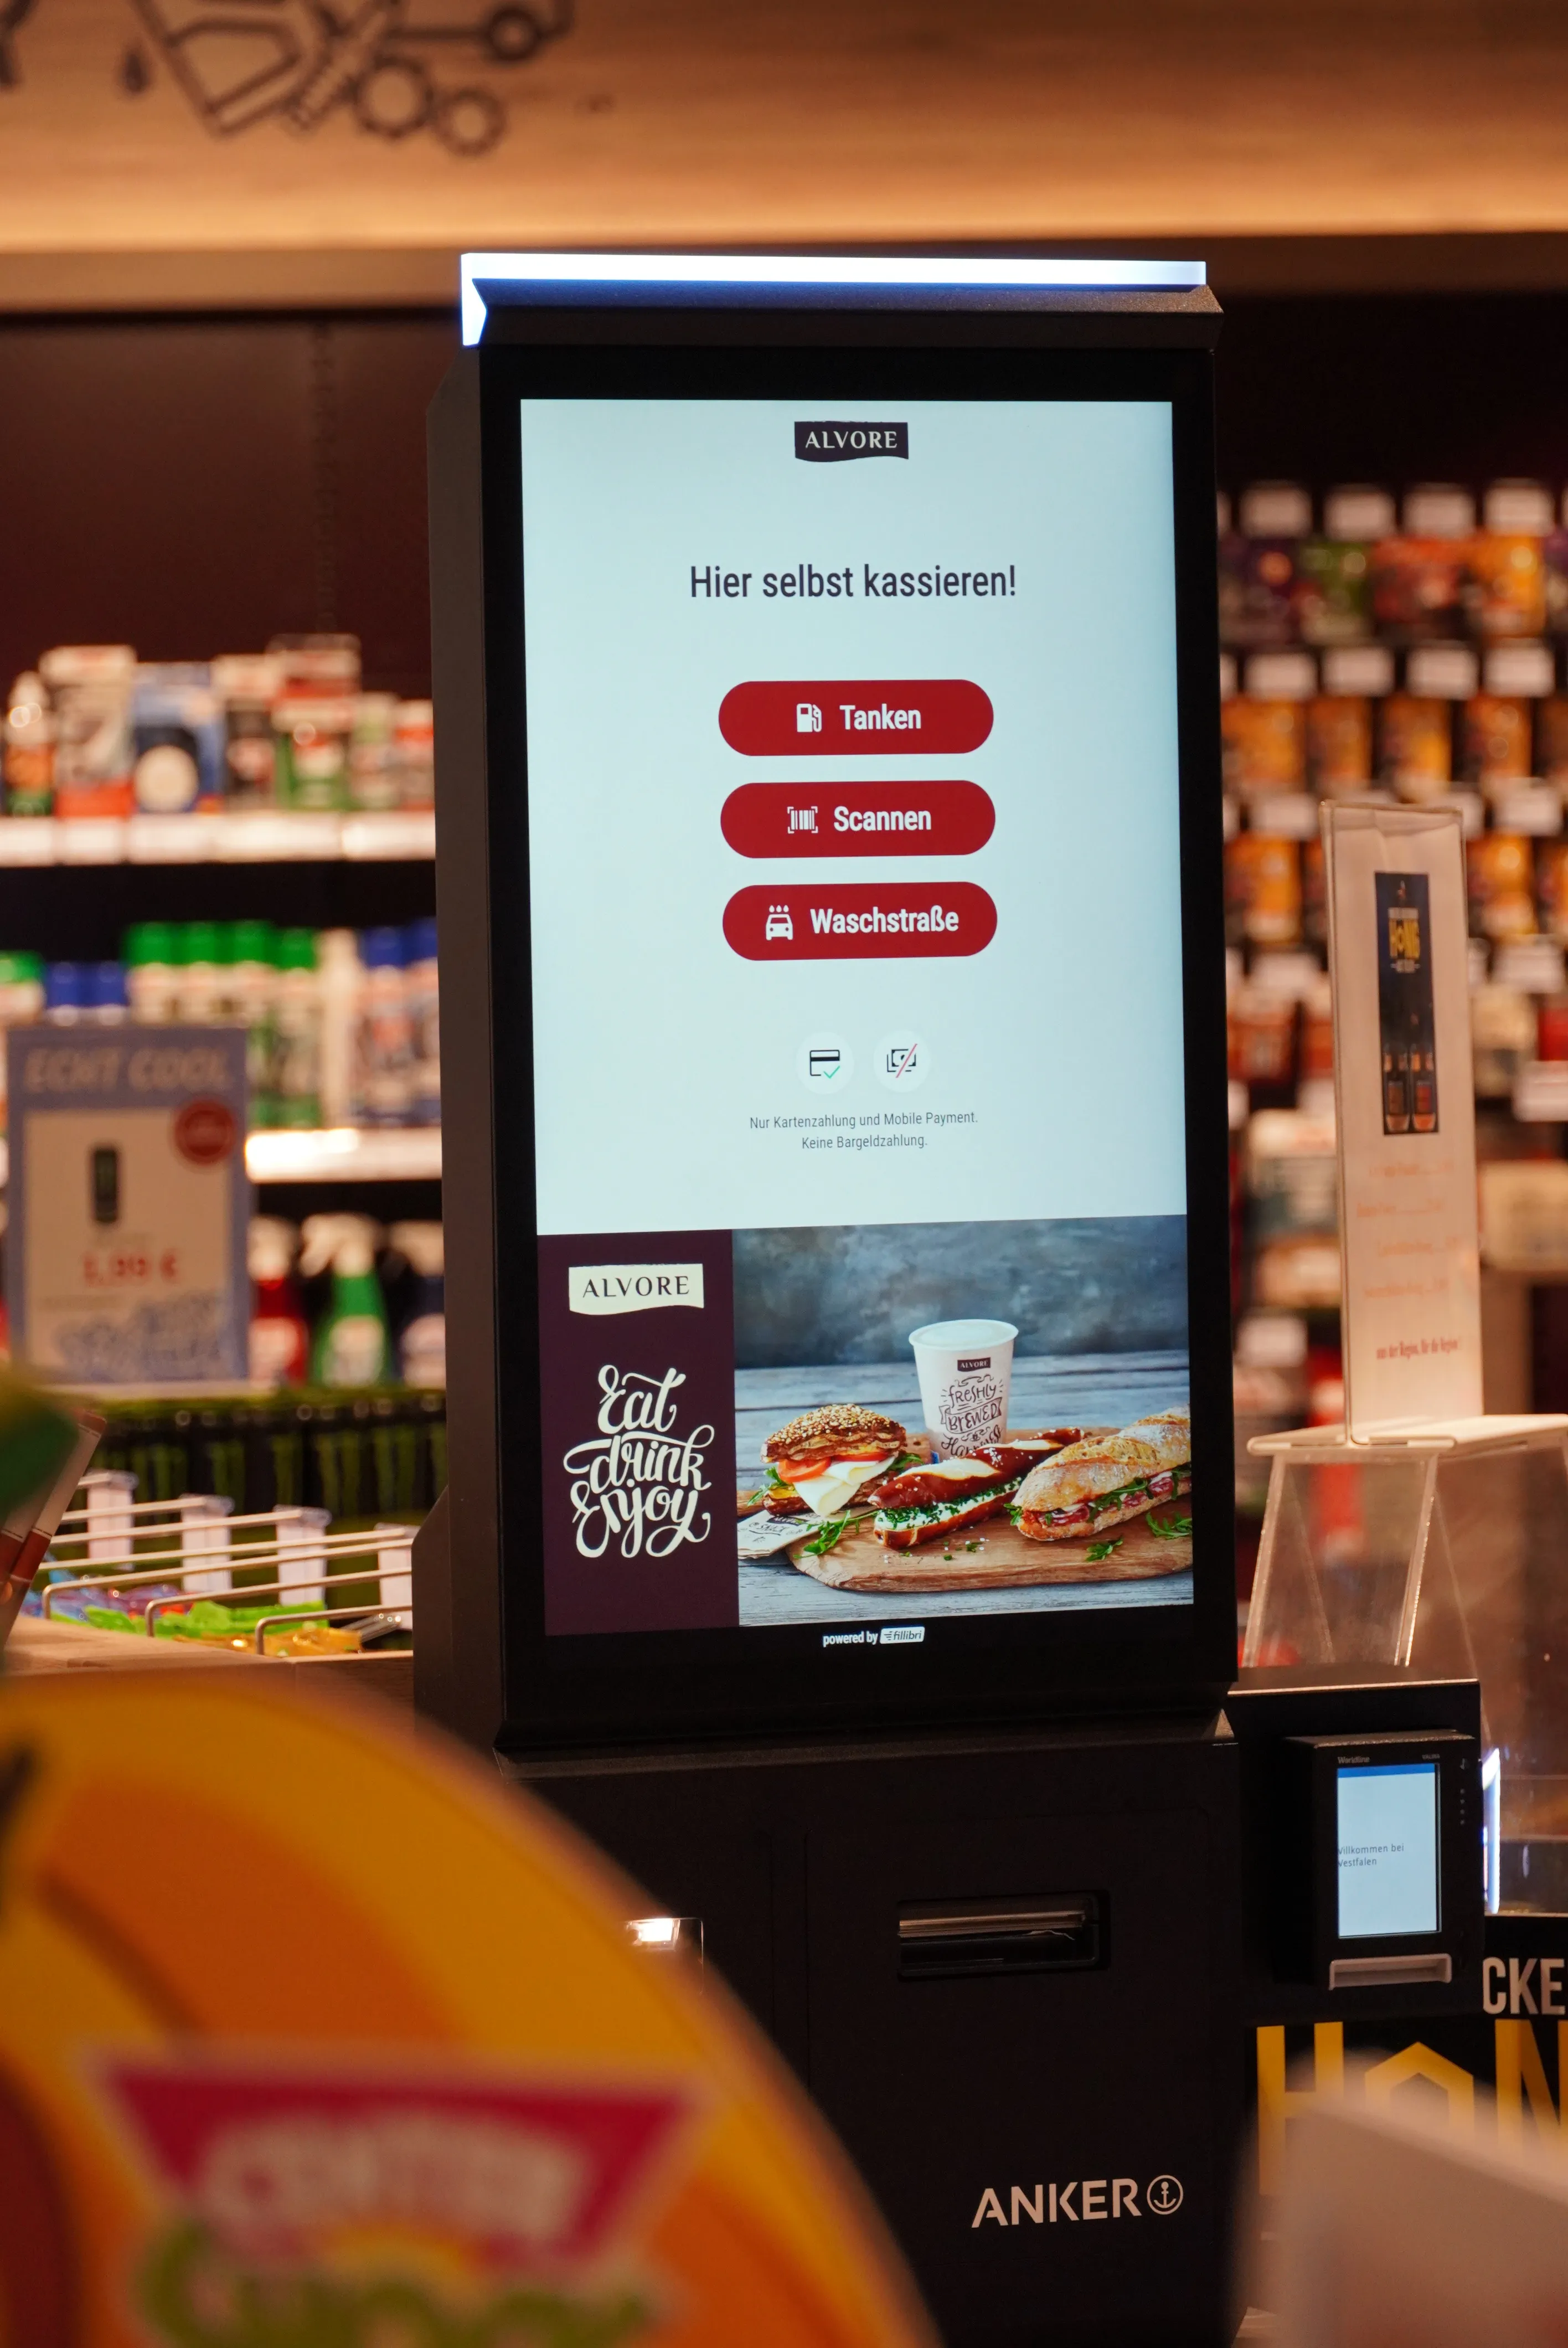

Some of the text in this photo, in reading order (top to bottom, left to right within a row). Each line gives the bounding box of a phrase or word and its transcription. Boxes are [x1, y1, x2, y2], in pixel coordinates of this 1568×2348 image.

[804, 430, 898, 450] ALVORE
[690, 563, 1016, 598] Hier selbst kassieren!
[839, 702, 922, 730] Tanken
[833, 805, 932, 832] Scannen
[809, 904, 960, 934] Waschstraße
[750, 1111, 978, 1130] Nur Kartenzahlung und Mobile Payment.
[802, 1134, 927, 1151] Keine Bargeldzahlung.
[582, 1275, 689, 1298] ALVORE
[597, 1364, 686, 1434] Eat
[563, 1424, 715, 1494] drink
[823, 1630, 922, 1648] powered by fillibri
[1391, 1843, 1404, 1852] bei
[971, 2177, 1143, 2229] ANKER
